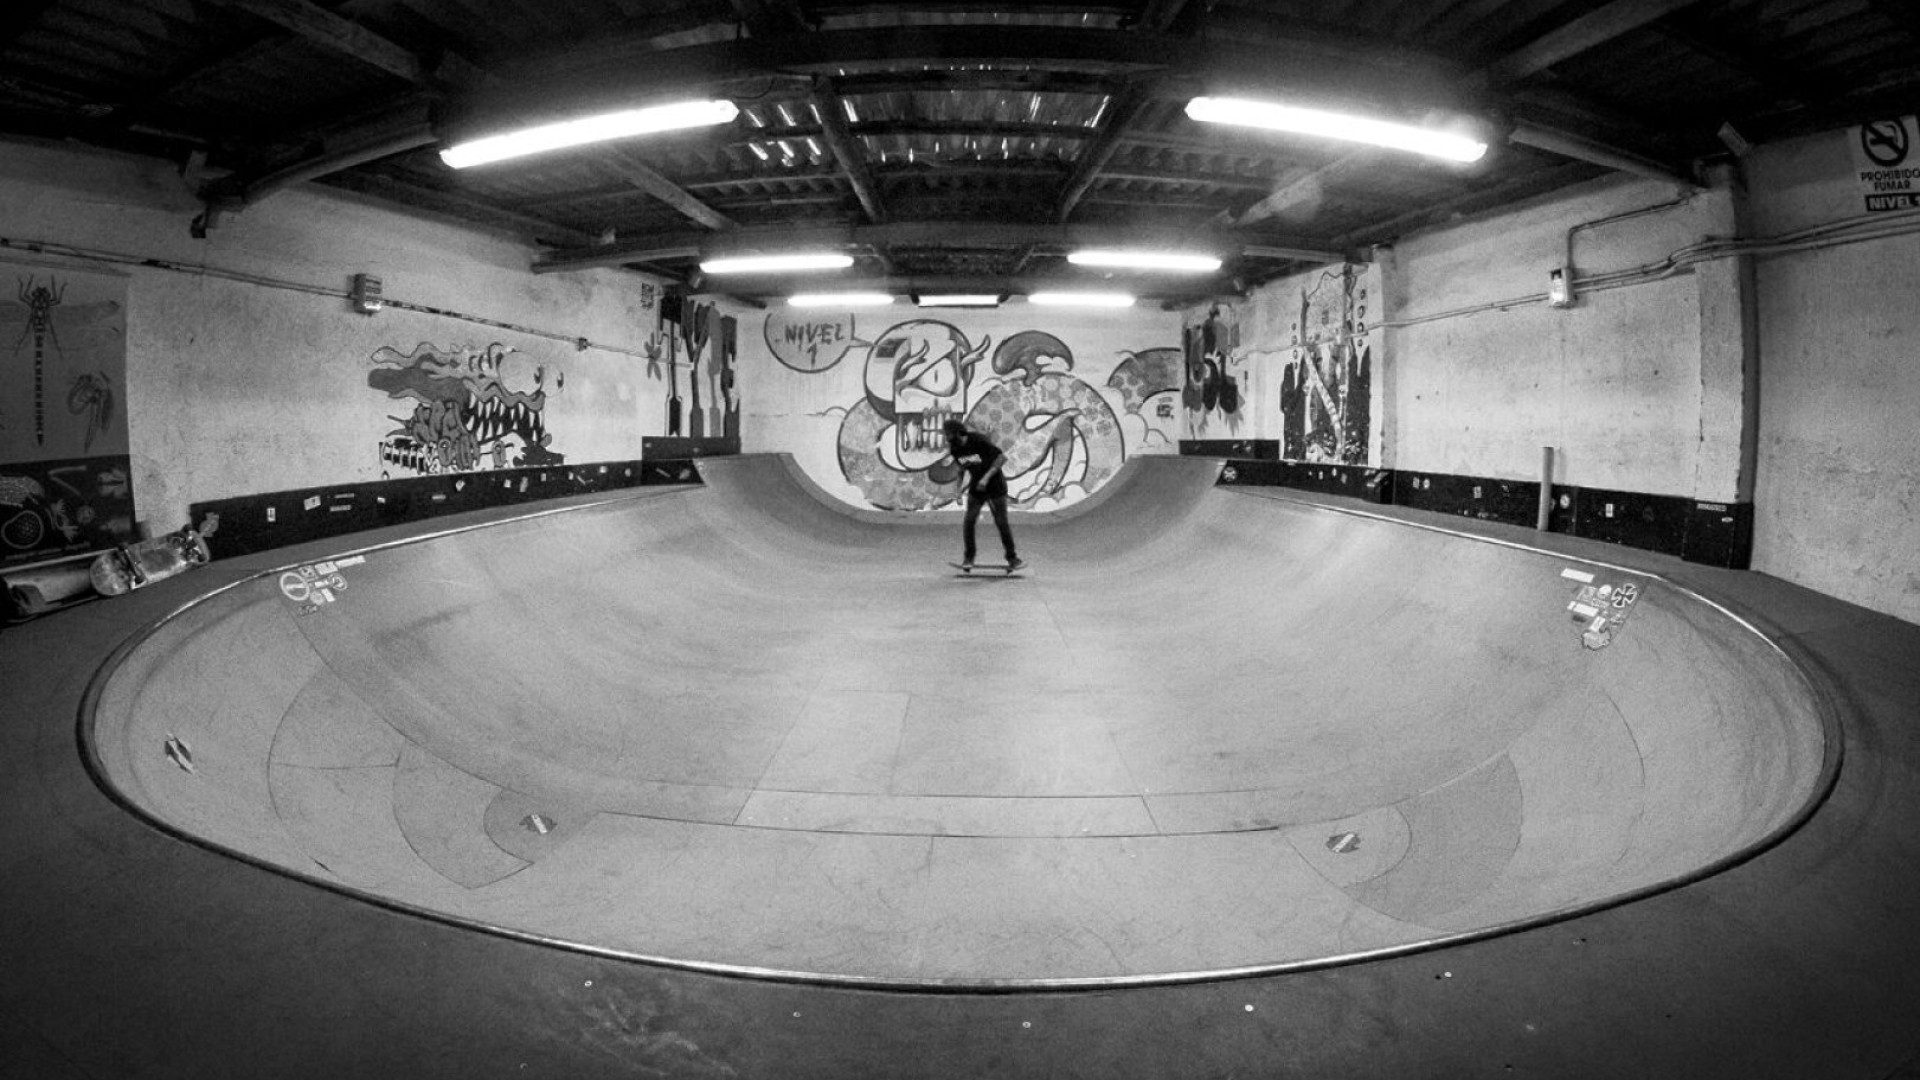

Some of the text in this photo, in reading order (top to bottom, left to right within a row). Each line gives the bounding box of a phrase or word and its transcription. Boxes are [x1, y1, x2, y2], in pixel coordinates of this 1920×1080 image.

[1861, 168, 1920, 181] PROHIBIDO
[1874, 179, 1911, 191] FUMAR
[1868, 195, 1914, 210] NIVEL
[785, 321, 844, 345] NIVEL
